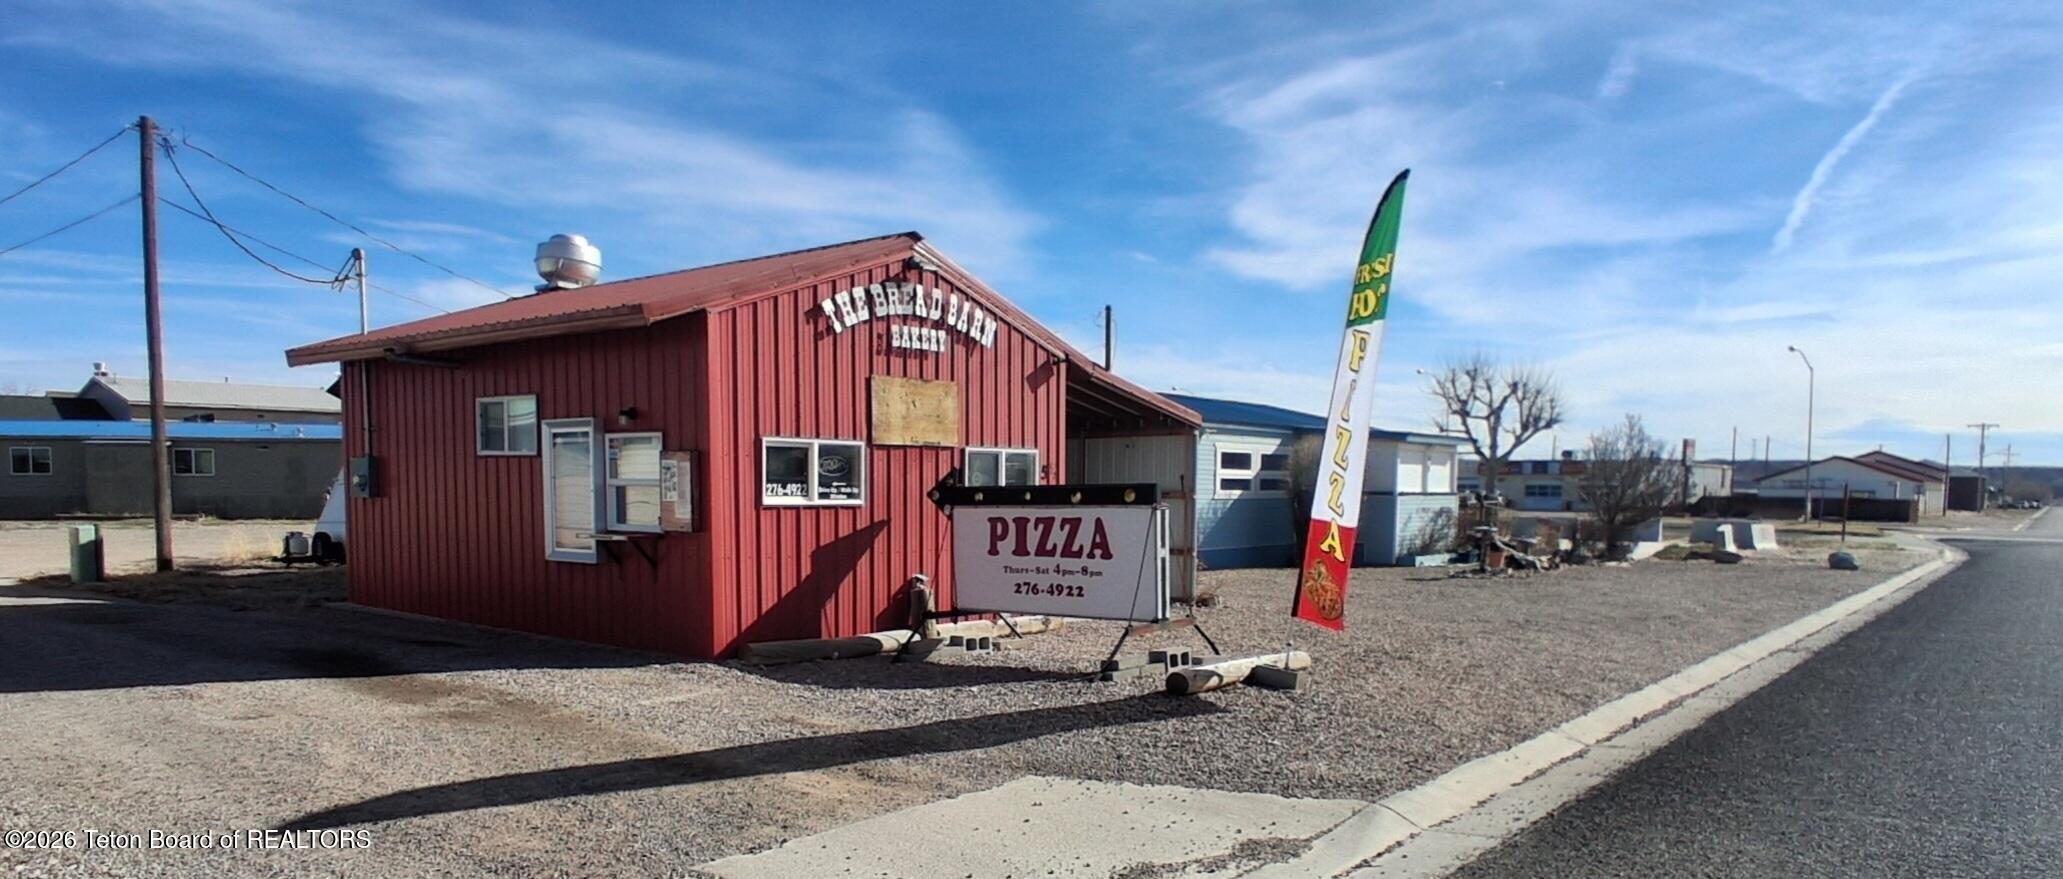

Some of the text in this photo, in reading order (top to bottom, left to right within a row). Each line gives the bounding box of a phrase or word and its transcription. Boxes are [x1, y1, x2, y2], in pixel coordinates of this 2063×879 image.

[822, 281, 997, 349] THE BREAD BARN
[891, 324, 947, 352] BAKERY
[1319, 329, 1372, 562] PIZZA
[766, 483, 808, 497] 276-4922
[987, 516, 1113, 560] PIZZA
